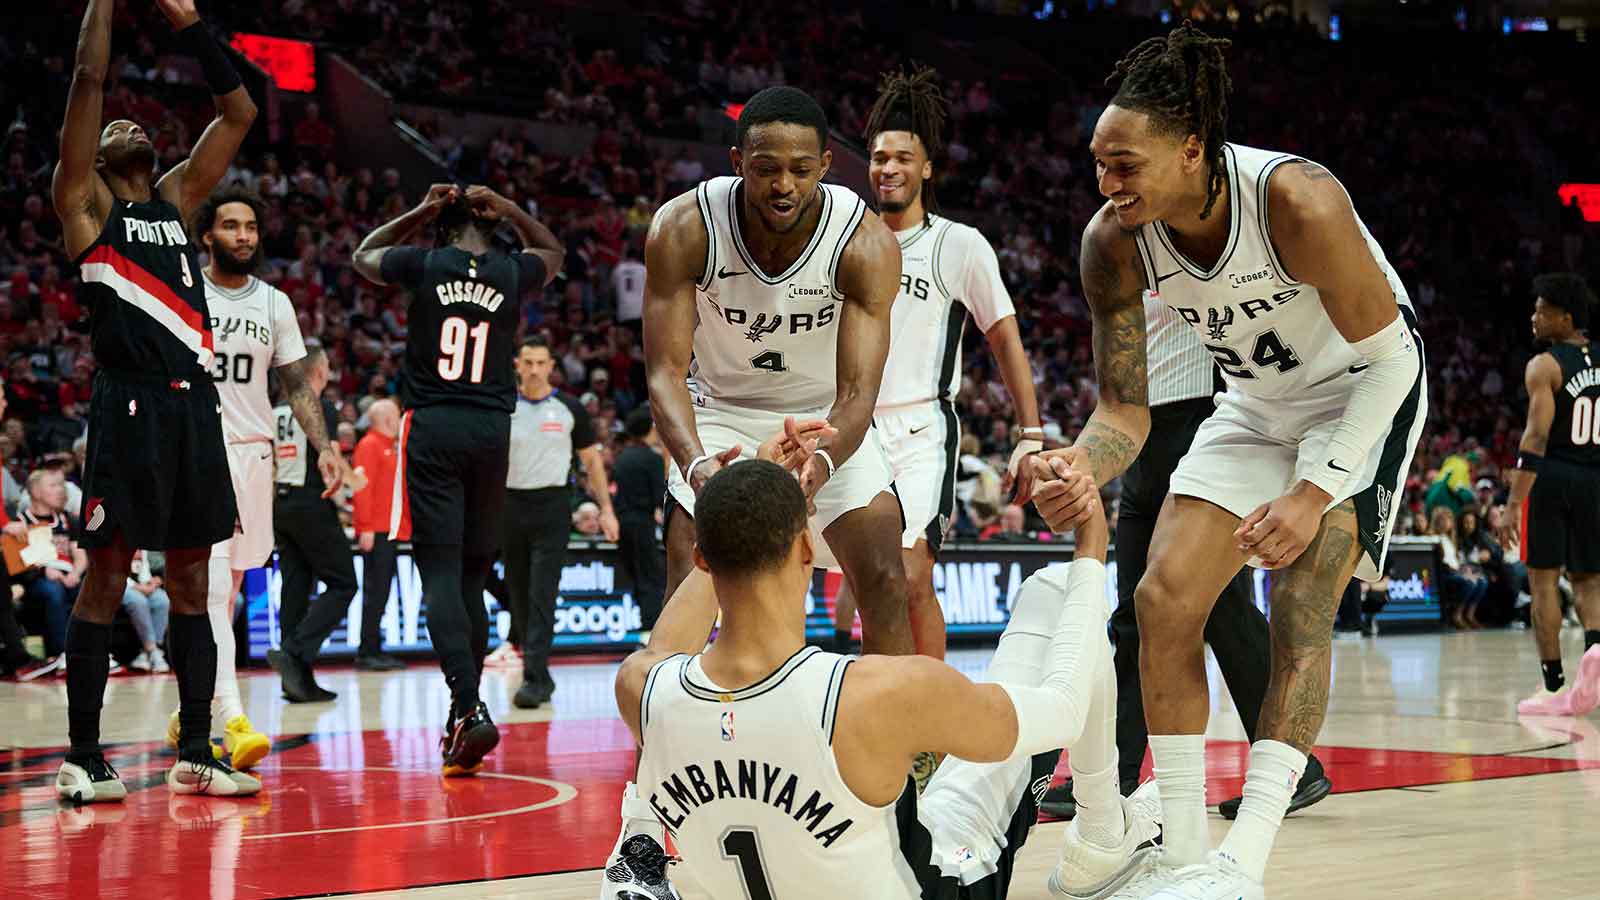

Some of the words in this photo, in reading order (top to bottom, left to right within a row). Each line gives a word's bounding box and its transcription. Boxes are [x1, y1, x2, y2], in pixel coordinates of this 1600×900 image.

[435, 280, 505, 313] CISSOKO
[793, 287, 825, 296] LEDGER
[1235, 270, 1269, 285] LEDGER
[208, 316, 270, 345] PURS
[707, 297, 835, 343] PURS
[1170, 289, 1300, 340] PURS
[210, 351, 253, 384] 30
[437, 316, 490, 383] 91
[750, 348, 788, 372] 4
[1203, 328, 1303, 379] 24
[650, 759, 854, 848] EMBANYAMA
[718, 825, 777, 900] 1
